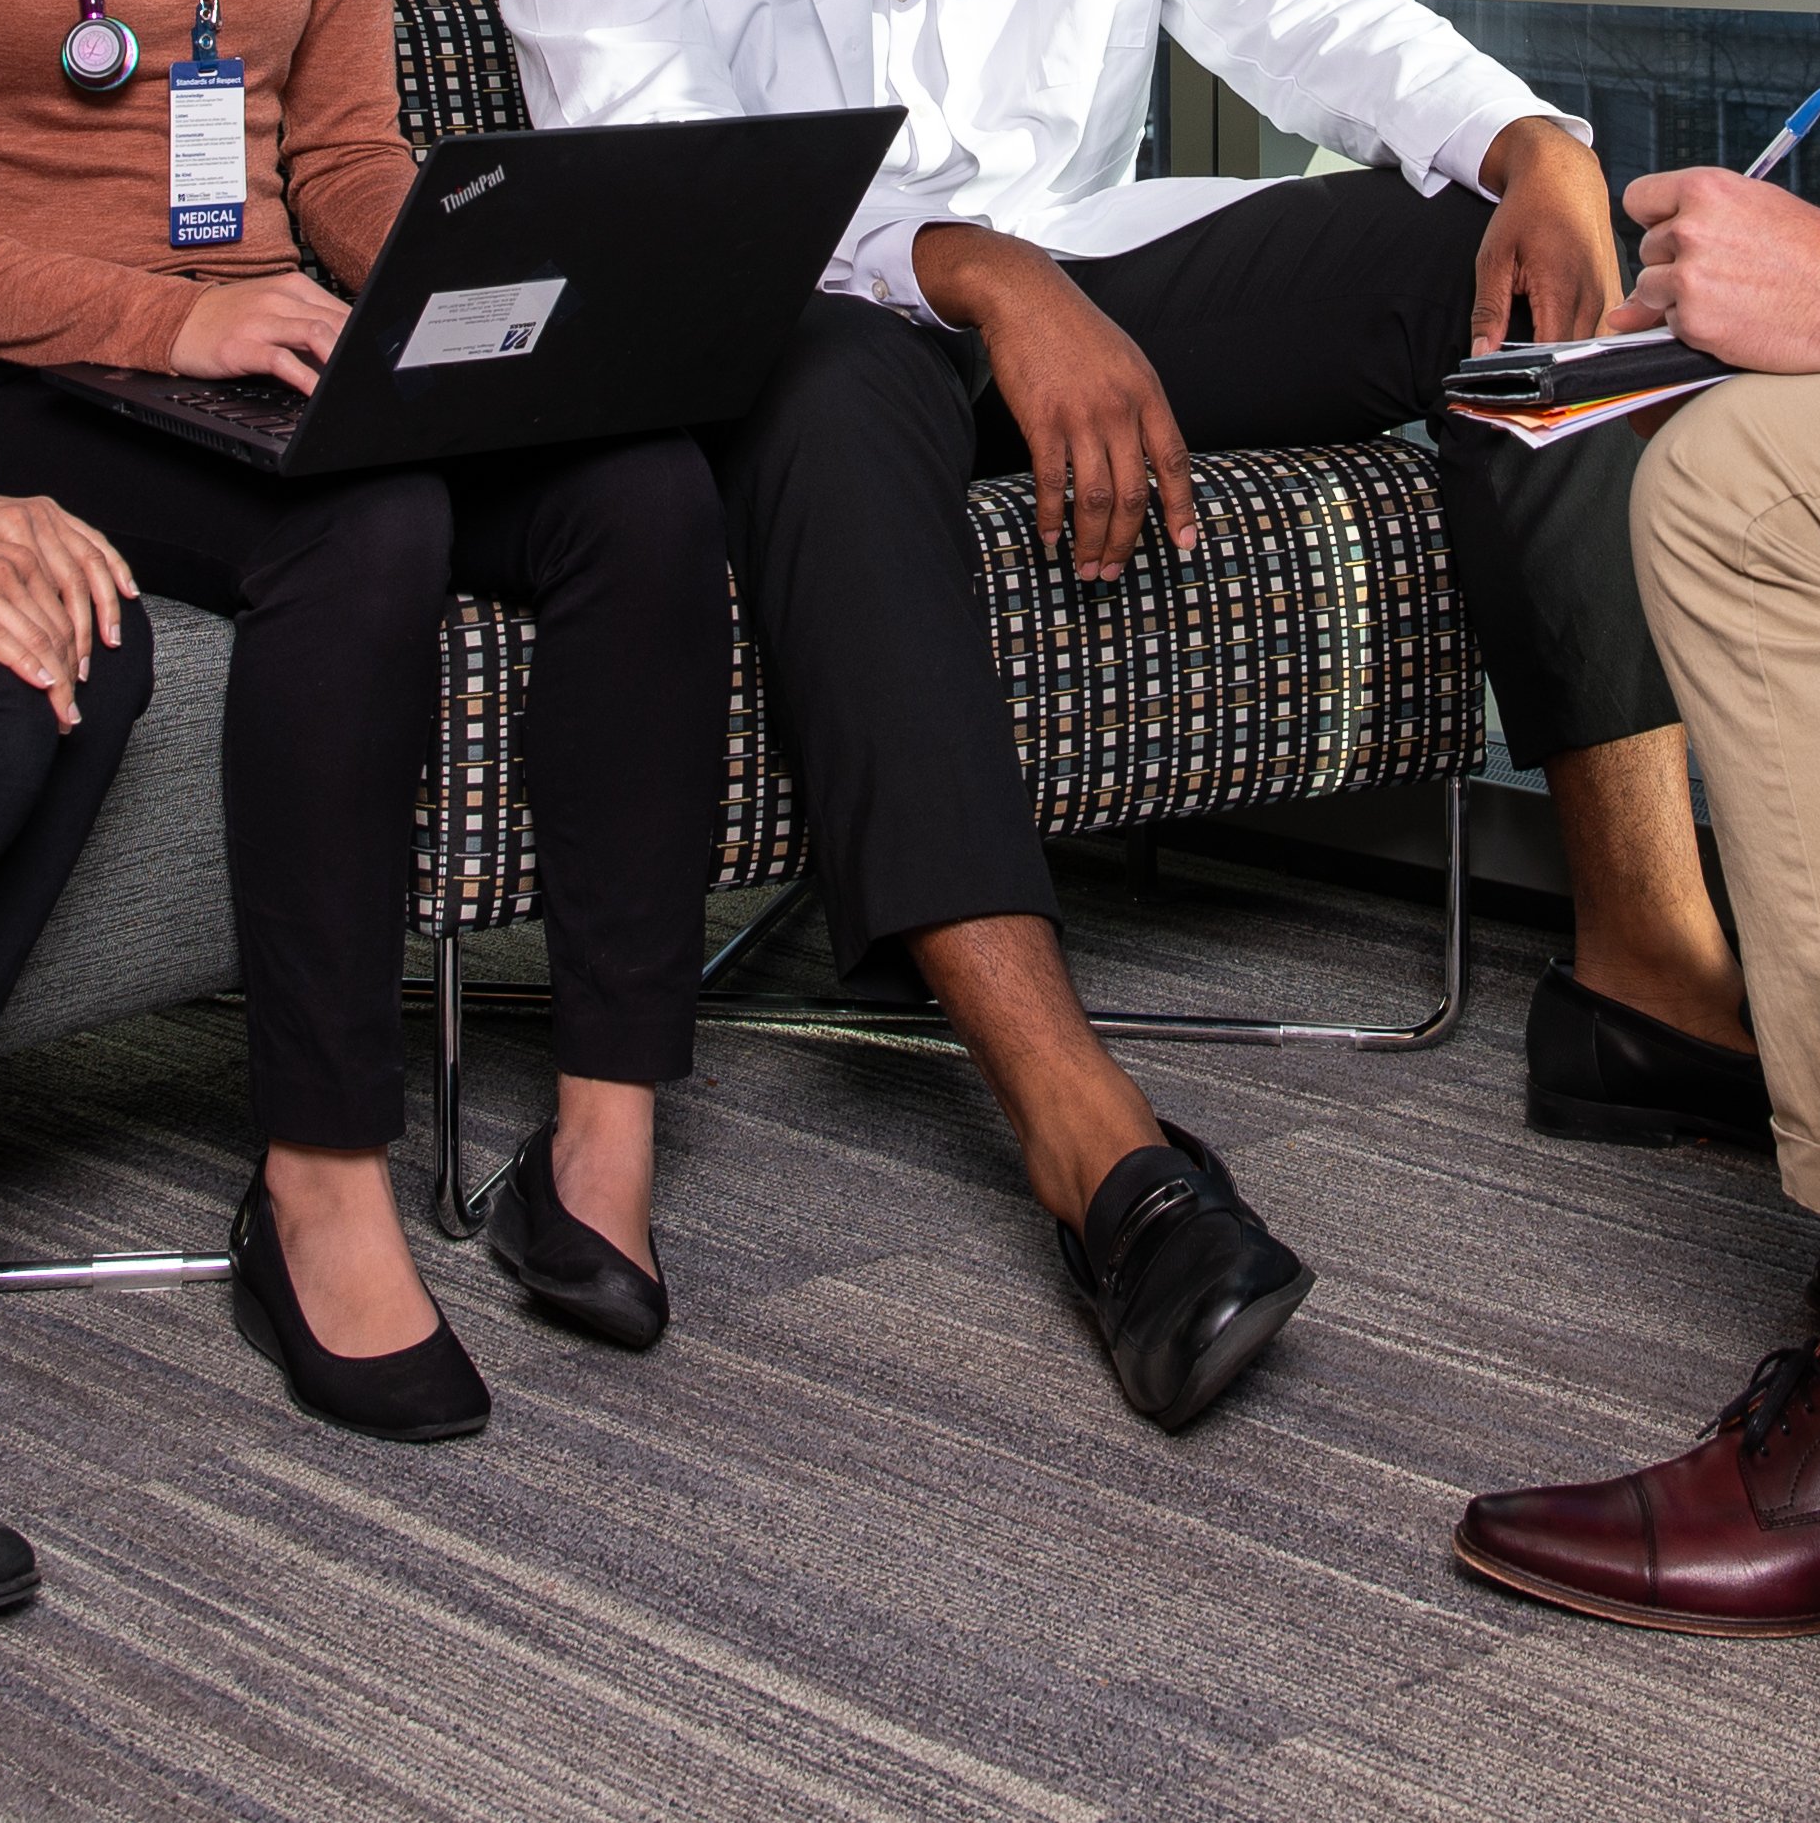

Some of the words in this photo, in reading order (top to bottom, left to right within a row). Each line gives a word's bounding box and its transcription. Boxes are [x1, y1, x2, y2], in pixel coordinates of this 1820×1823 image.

[176, 78, 208, 86] Standards
[216, 77, 242, 85] Respect
[440, 164, 505, 214] ThinkPad
[179, 209, 237, 226] MEDICAL
[178, 225, 237, 241] STUDENT
